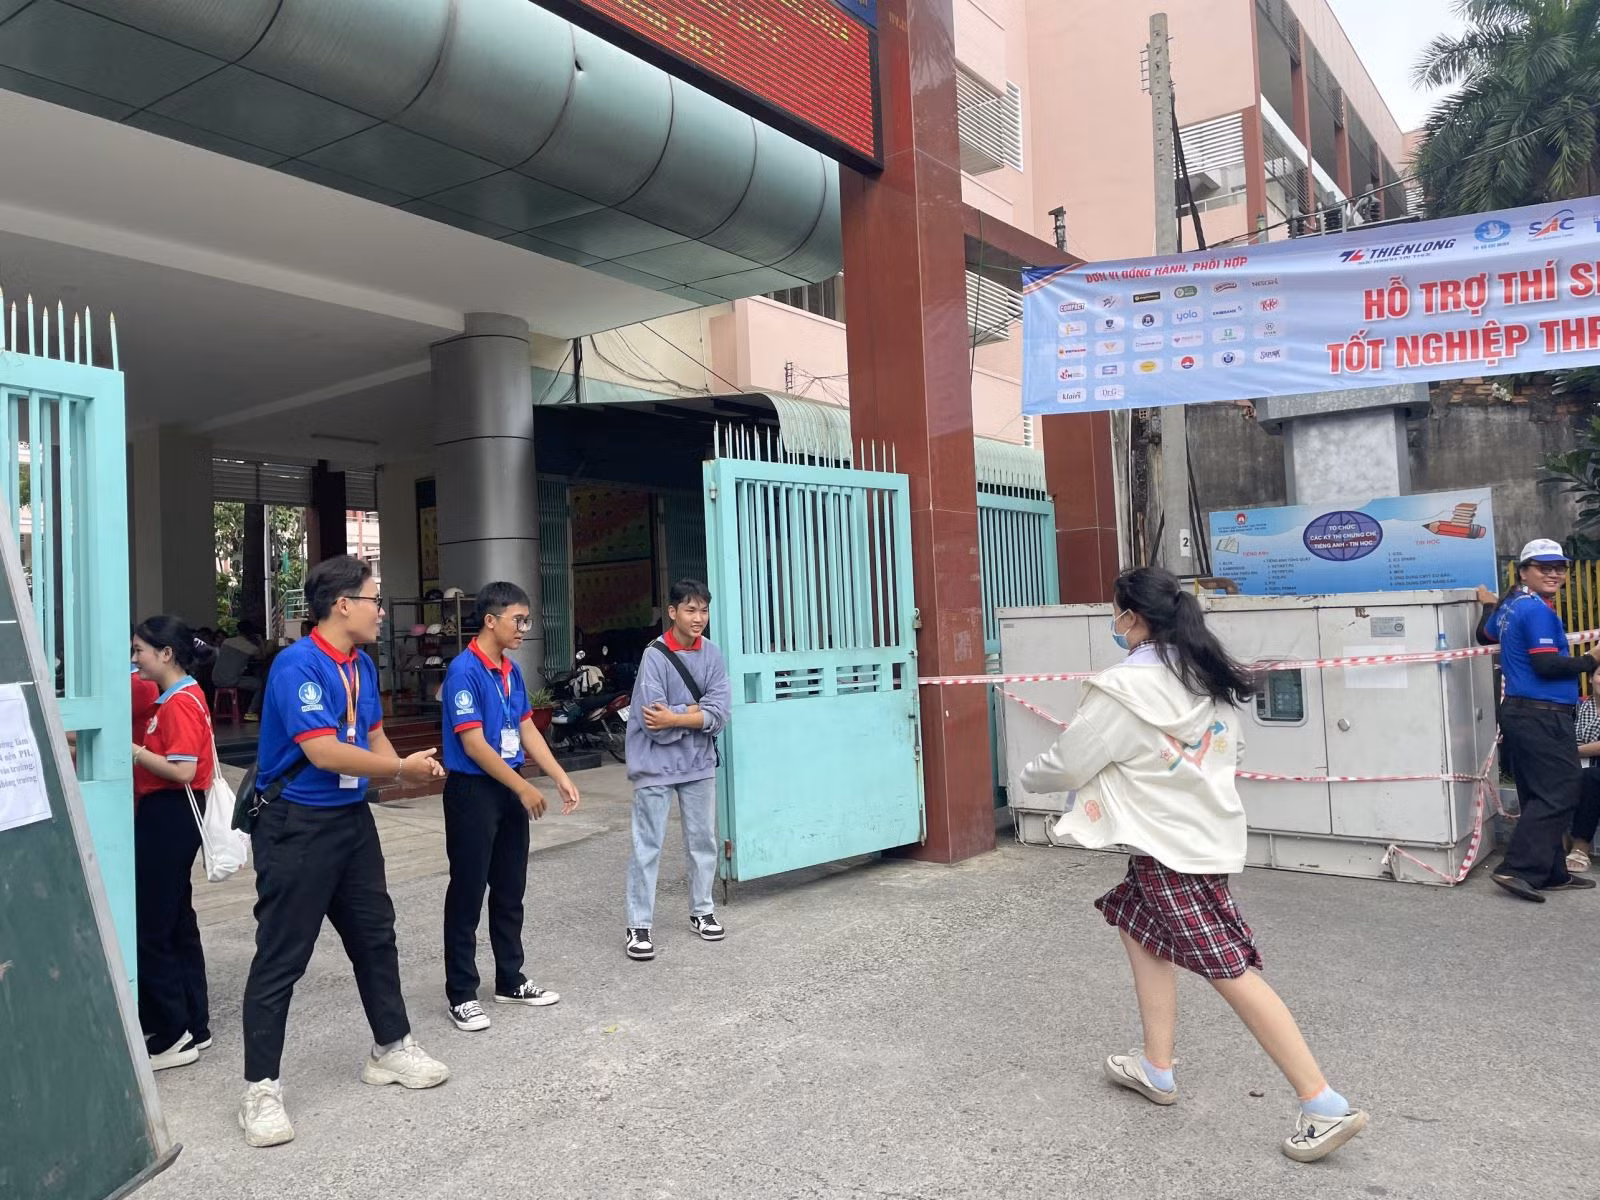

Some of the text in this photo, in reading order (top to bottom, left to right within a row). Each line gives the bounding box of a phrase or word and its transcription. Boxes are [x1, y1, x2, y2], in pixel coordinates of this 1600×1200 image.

[1223, 256, 1249, 269] HỢP
[1363, 275, 1410, 321] HỖ
[1419, 272, 1489, 316] TRỢ
[1498, 260, 1558, 305] THÍ
[1176, 309, 1198, 321] yola
[1327, 328, 1386, 374] TỐT
[1394, 319, 1530, 367] NGHIỆP
